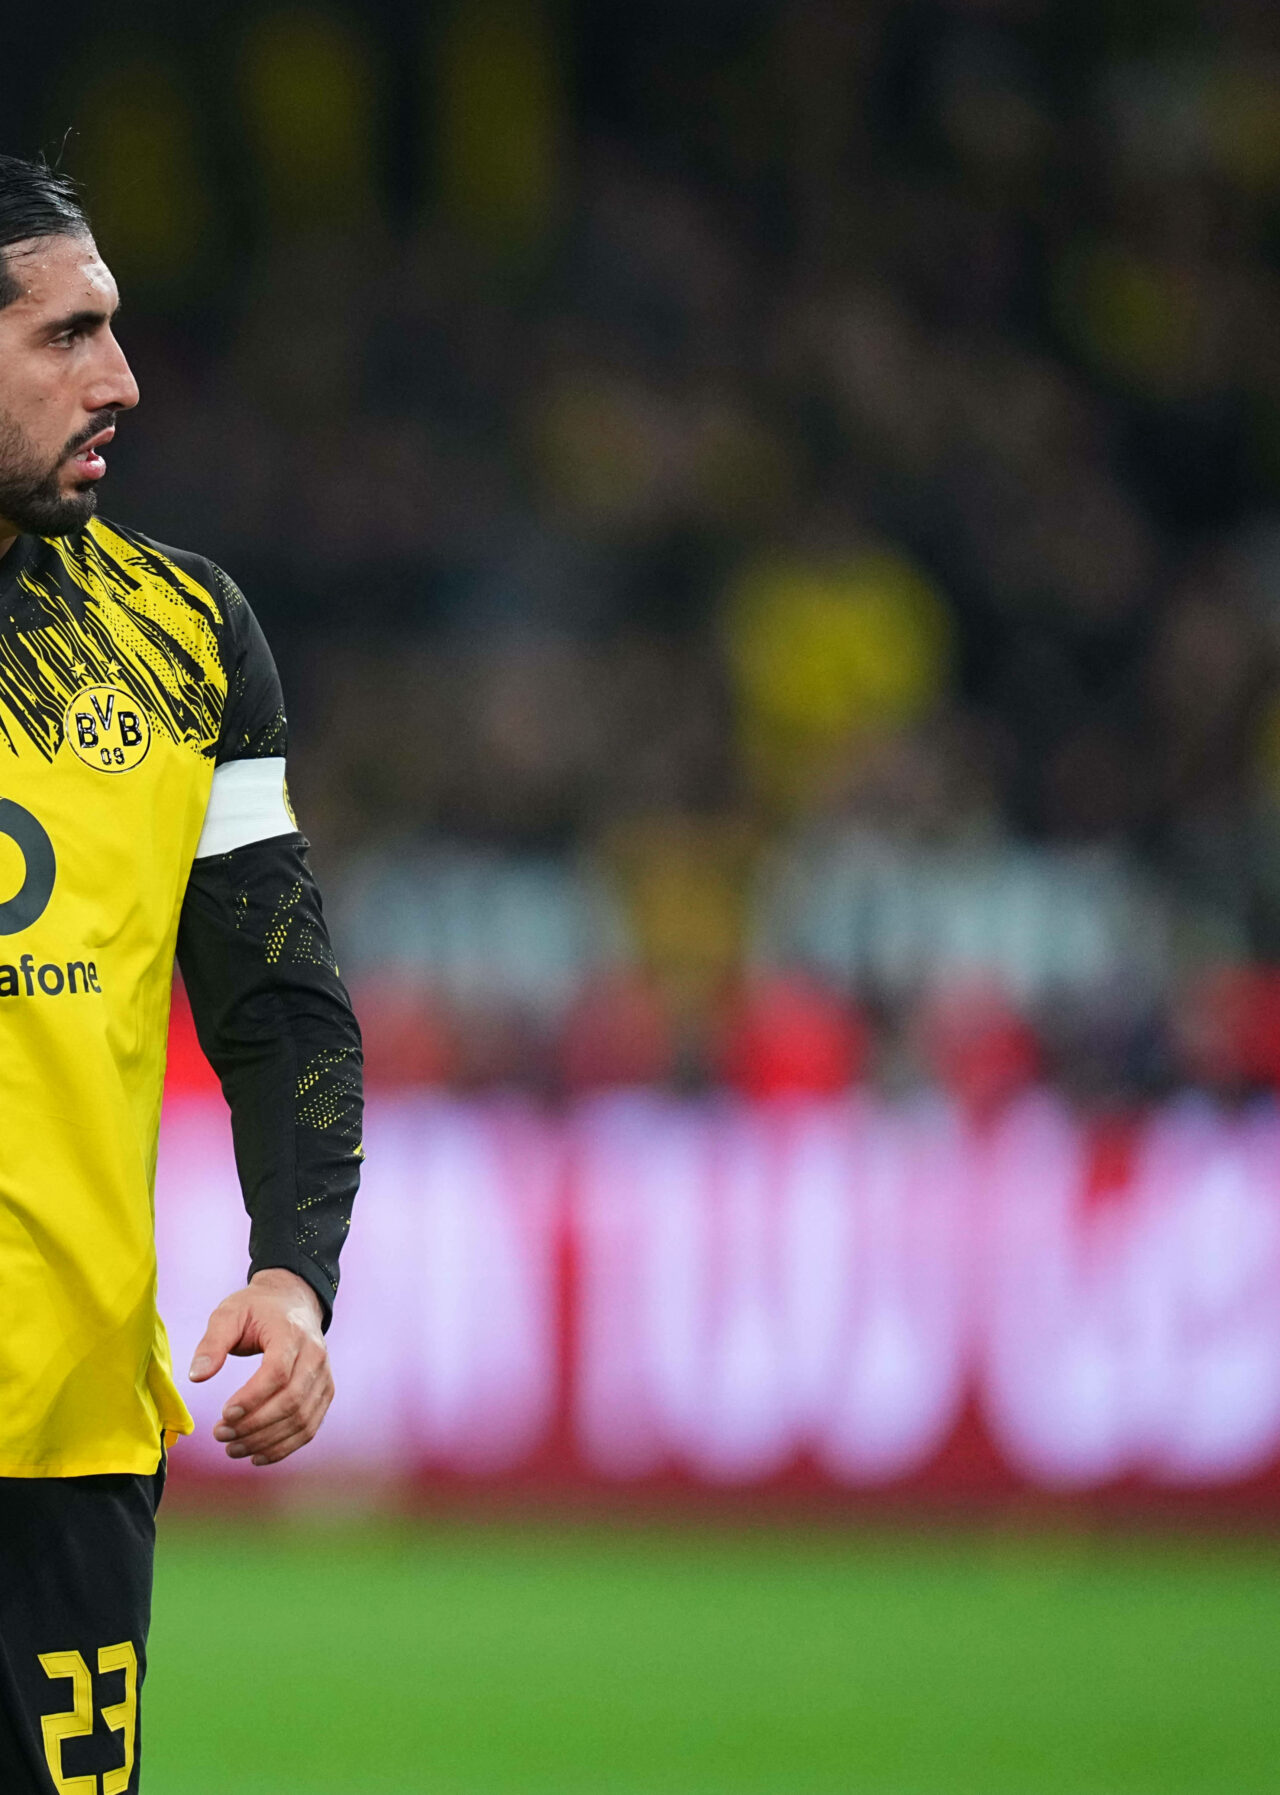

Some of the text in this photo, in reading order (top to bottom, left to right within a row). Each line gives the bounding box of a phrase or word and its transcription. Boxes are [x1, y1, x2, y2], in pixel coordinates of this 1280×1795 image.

[75, 694, 142, 748] BVB
[100, 747, 125, 766] 09
[37, 1640, 138, 1795] 23
